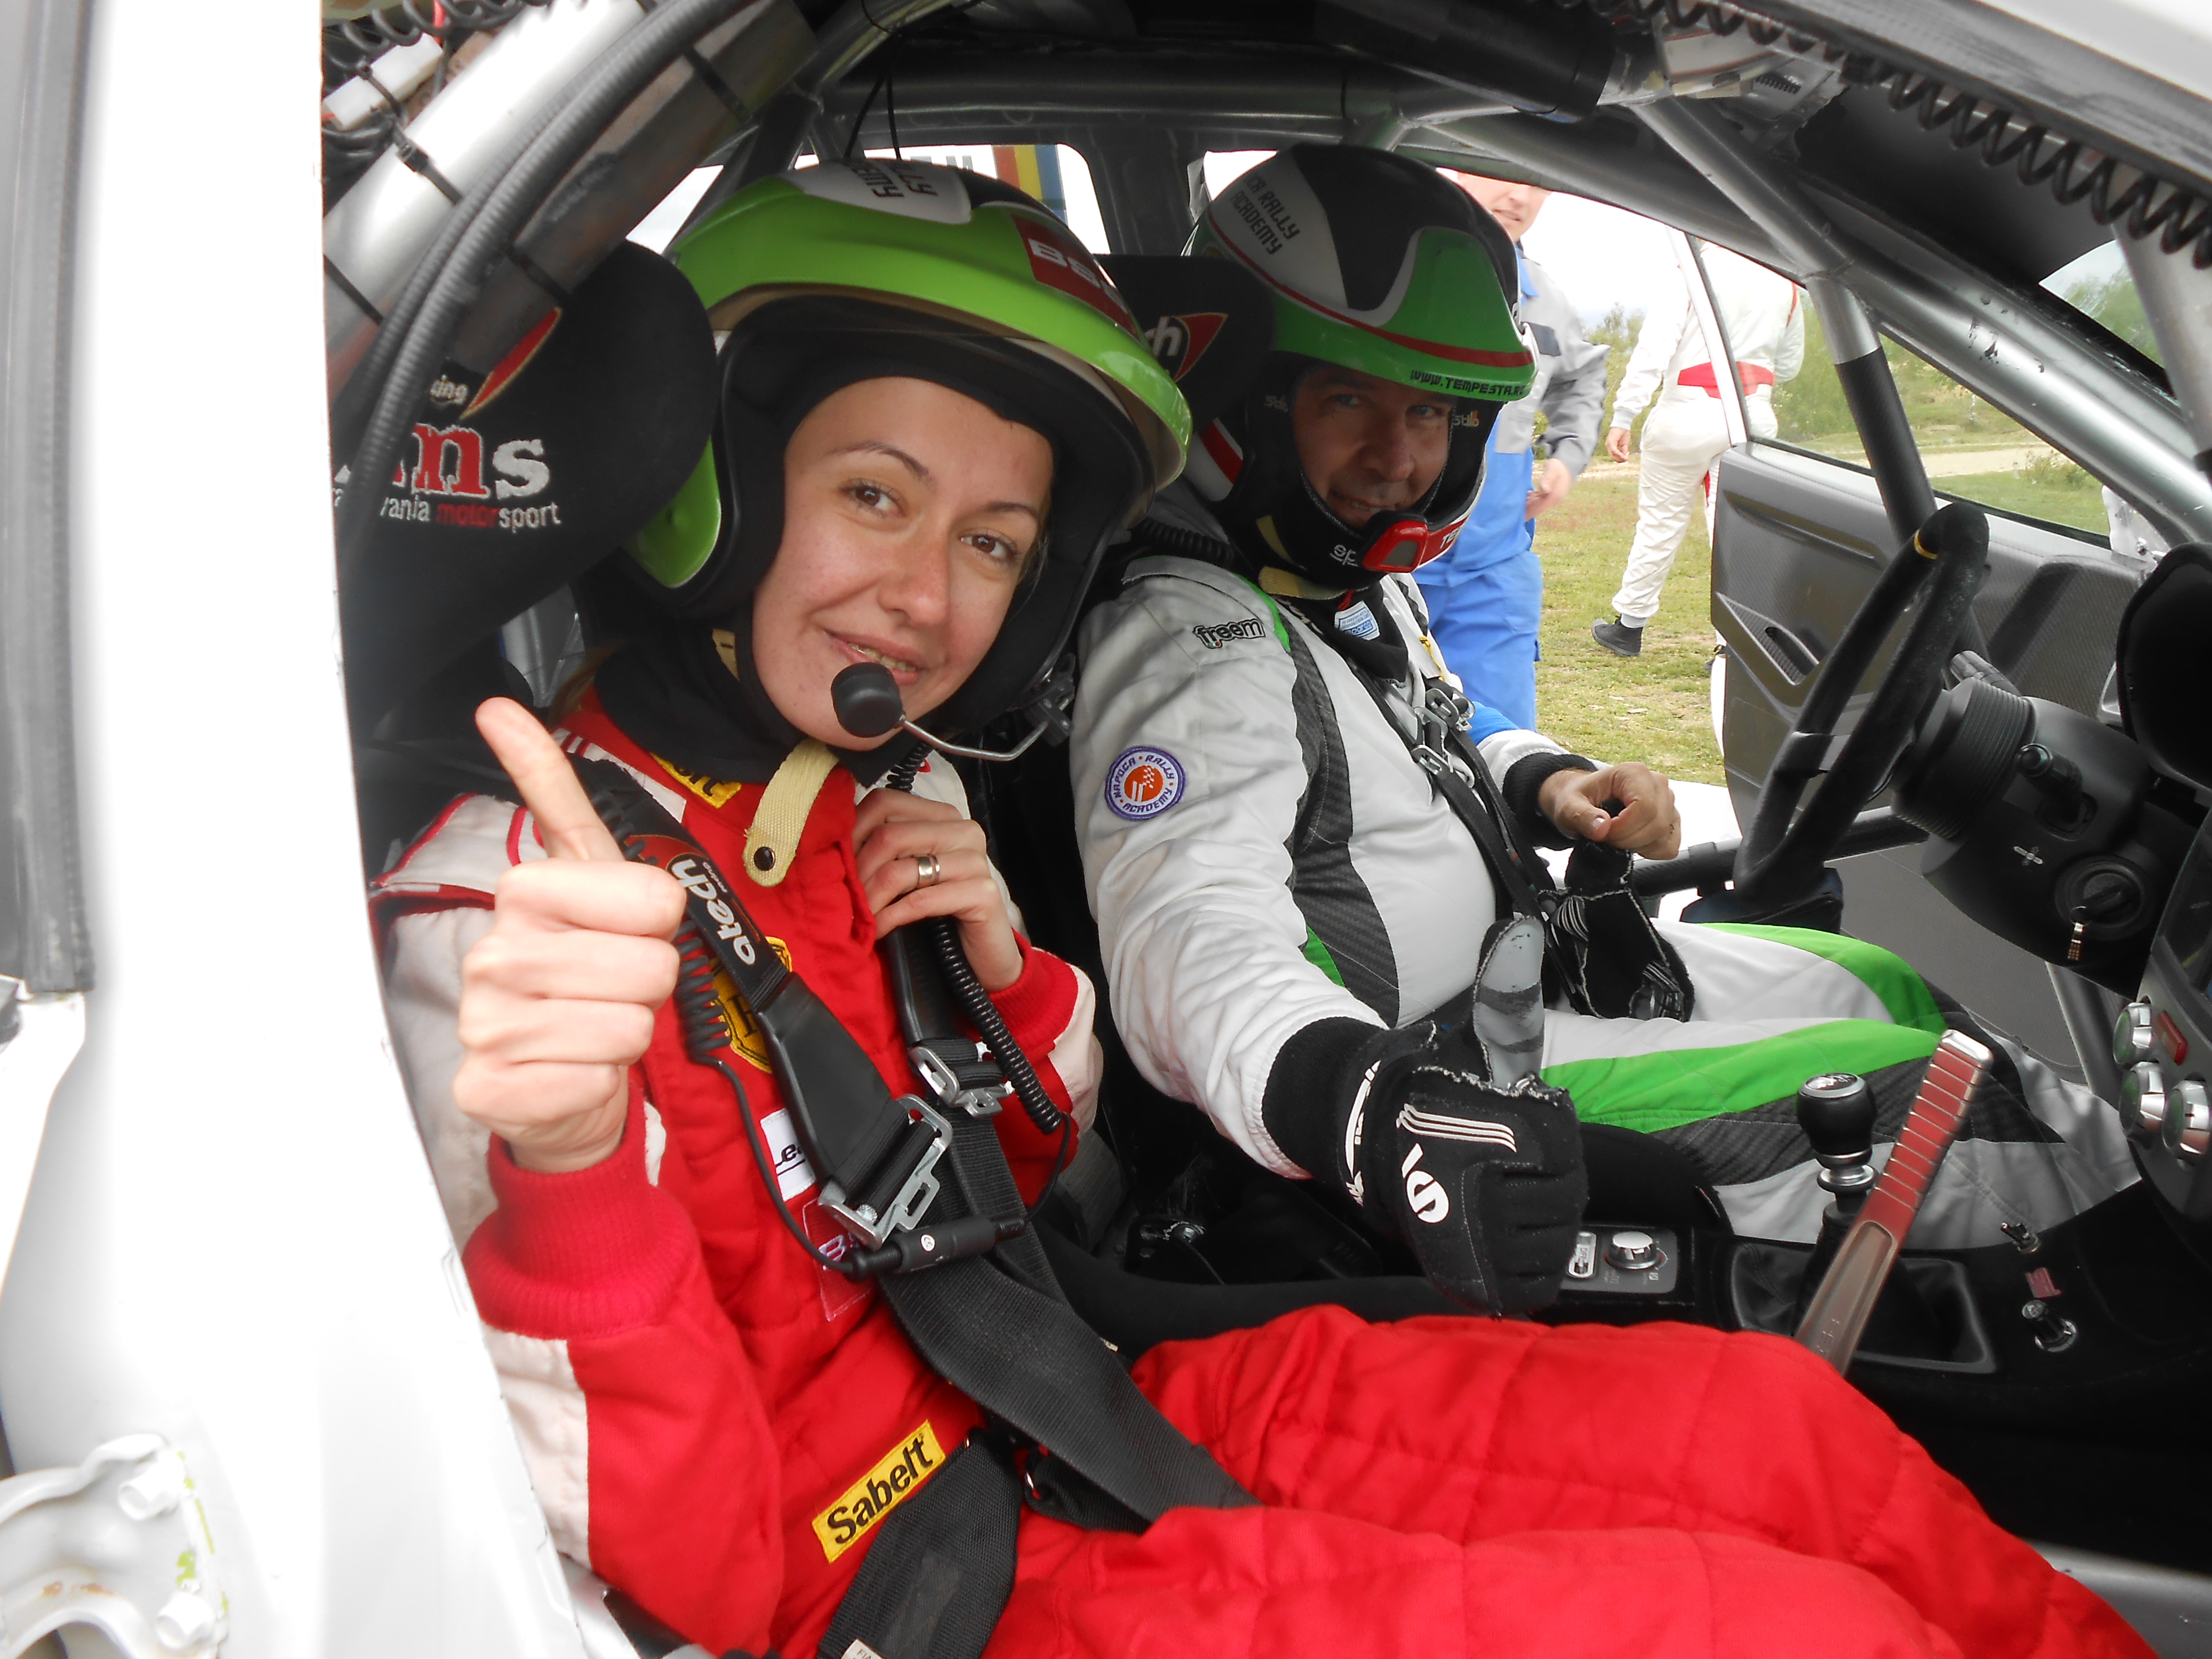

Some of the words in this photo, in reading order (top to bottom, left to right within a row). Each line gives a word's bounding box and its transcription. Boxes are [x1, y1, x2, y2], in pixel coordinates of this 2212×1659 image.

[1230, 191, 1284, 255] ACADEMY
[1258, 191, 1301, 240] RALLY
[1194, 619, 1264, 648] freem
[1113, 757, 1136, 798] NAPOCA
[1145, 755, 1175, 780] RALLY
[1122, 787, 1173, 813] ACADEMY
[827, 1436, 933, 1544] Sabelt
